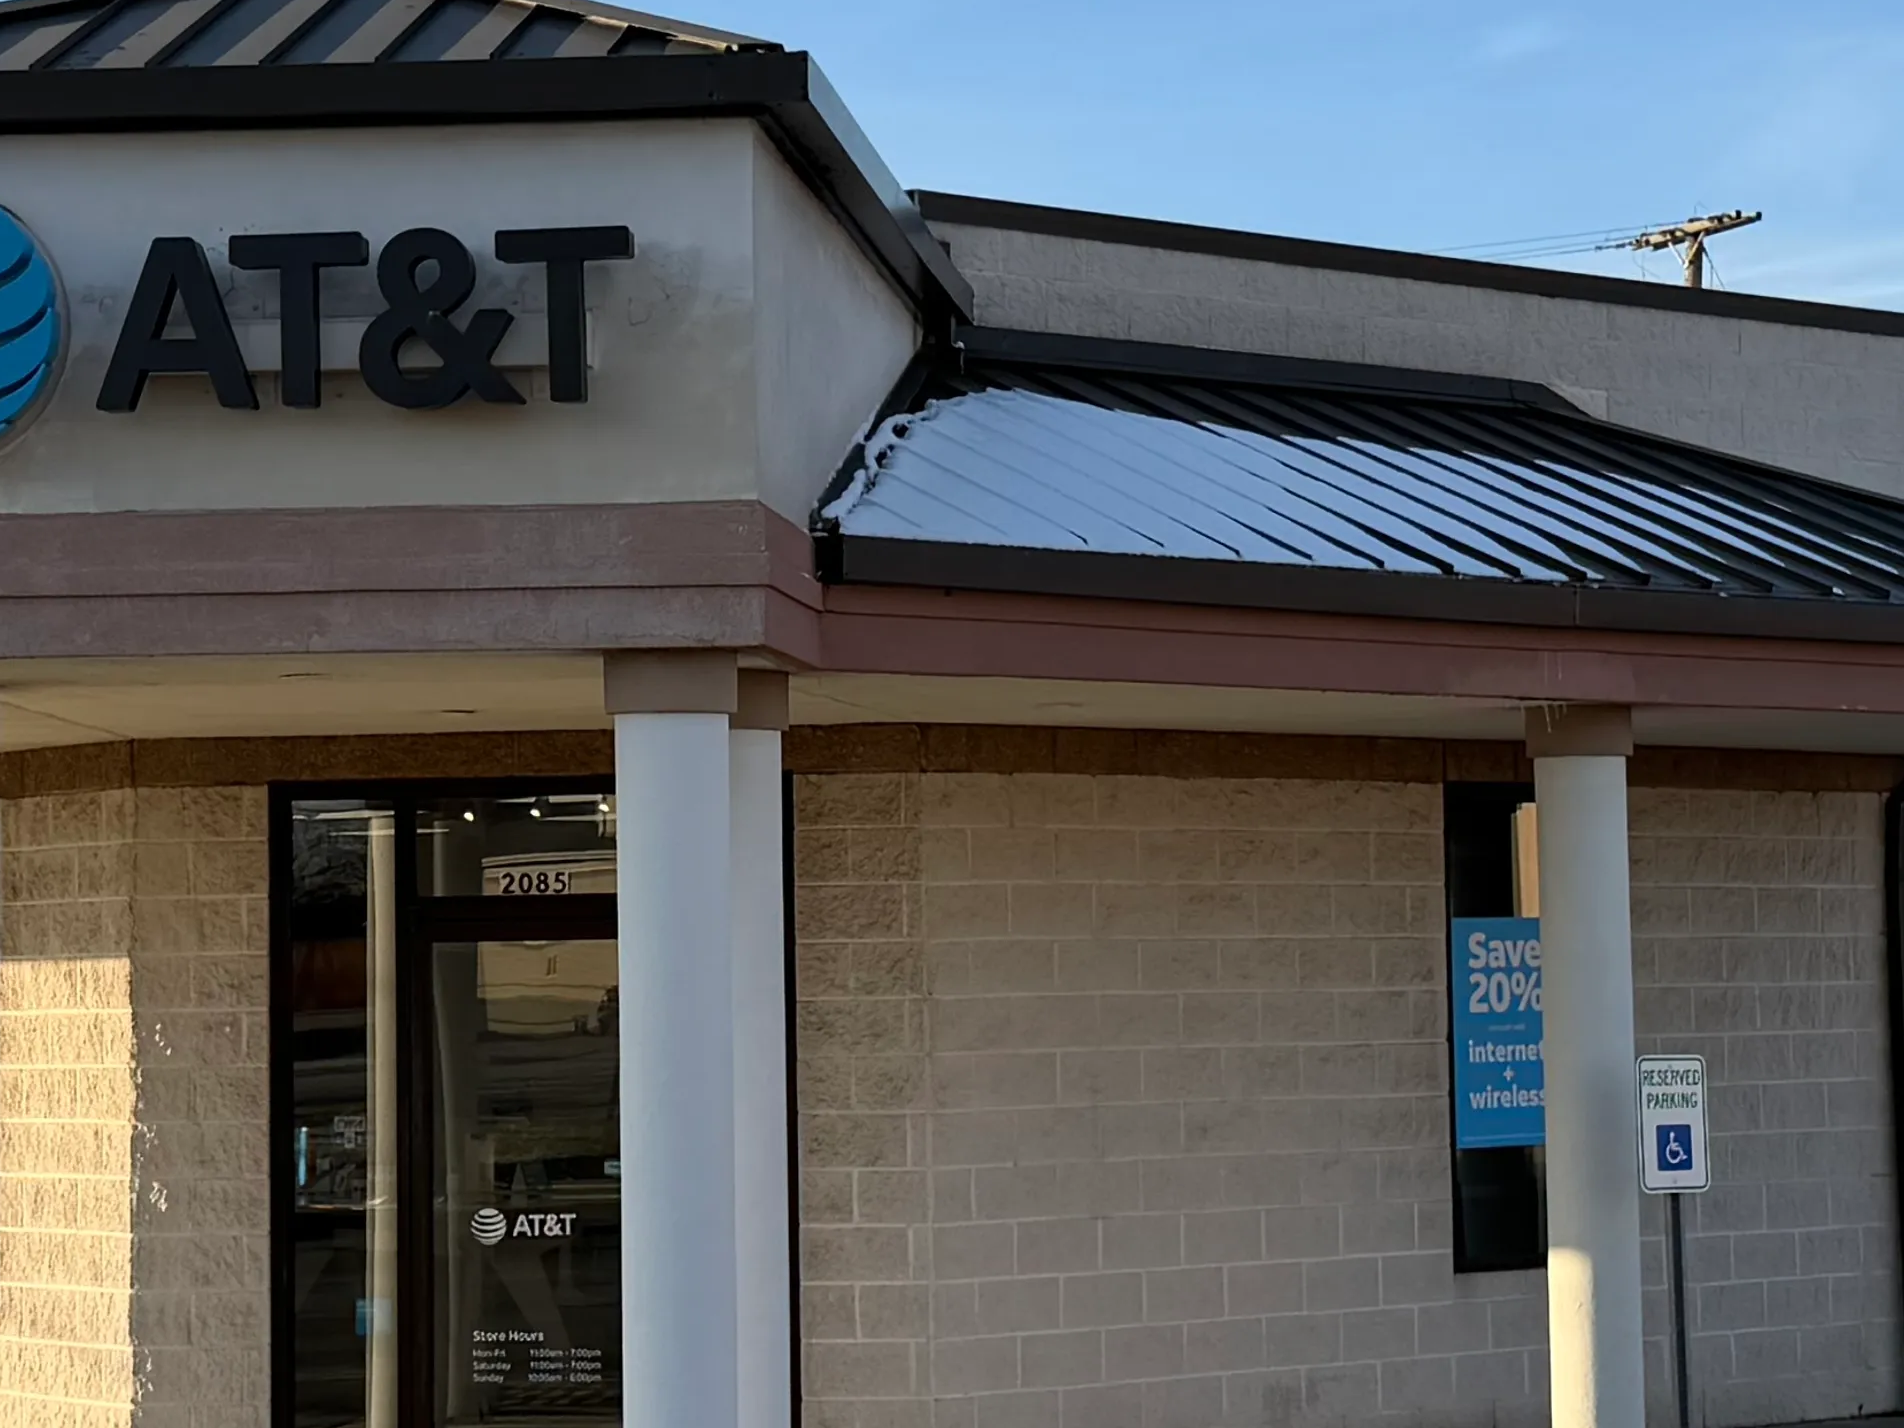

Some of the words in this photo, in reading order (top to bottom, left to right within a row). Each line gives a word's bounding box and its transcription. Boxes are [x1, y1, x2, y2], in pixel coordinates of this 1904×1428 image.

[96, 224, 635, 413] AT&T
[501, 872, 566, 894] 2085
[1468, 932, 1541, 969] Save
[1642, 1069, 1701, 1087] RESERVED
[1646, 1092, 1698, 1110] PARKING
[513, 1214, 576, 1237] AT&T
[473, 1330, 506, 1341] Store
[508, 1330, 544, 1341] Hours
